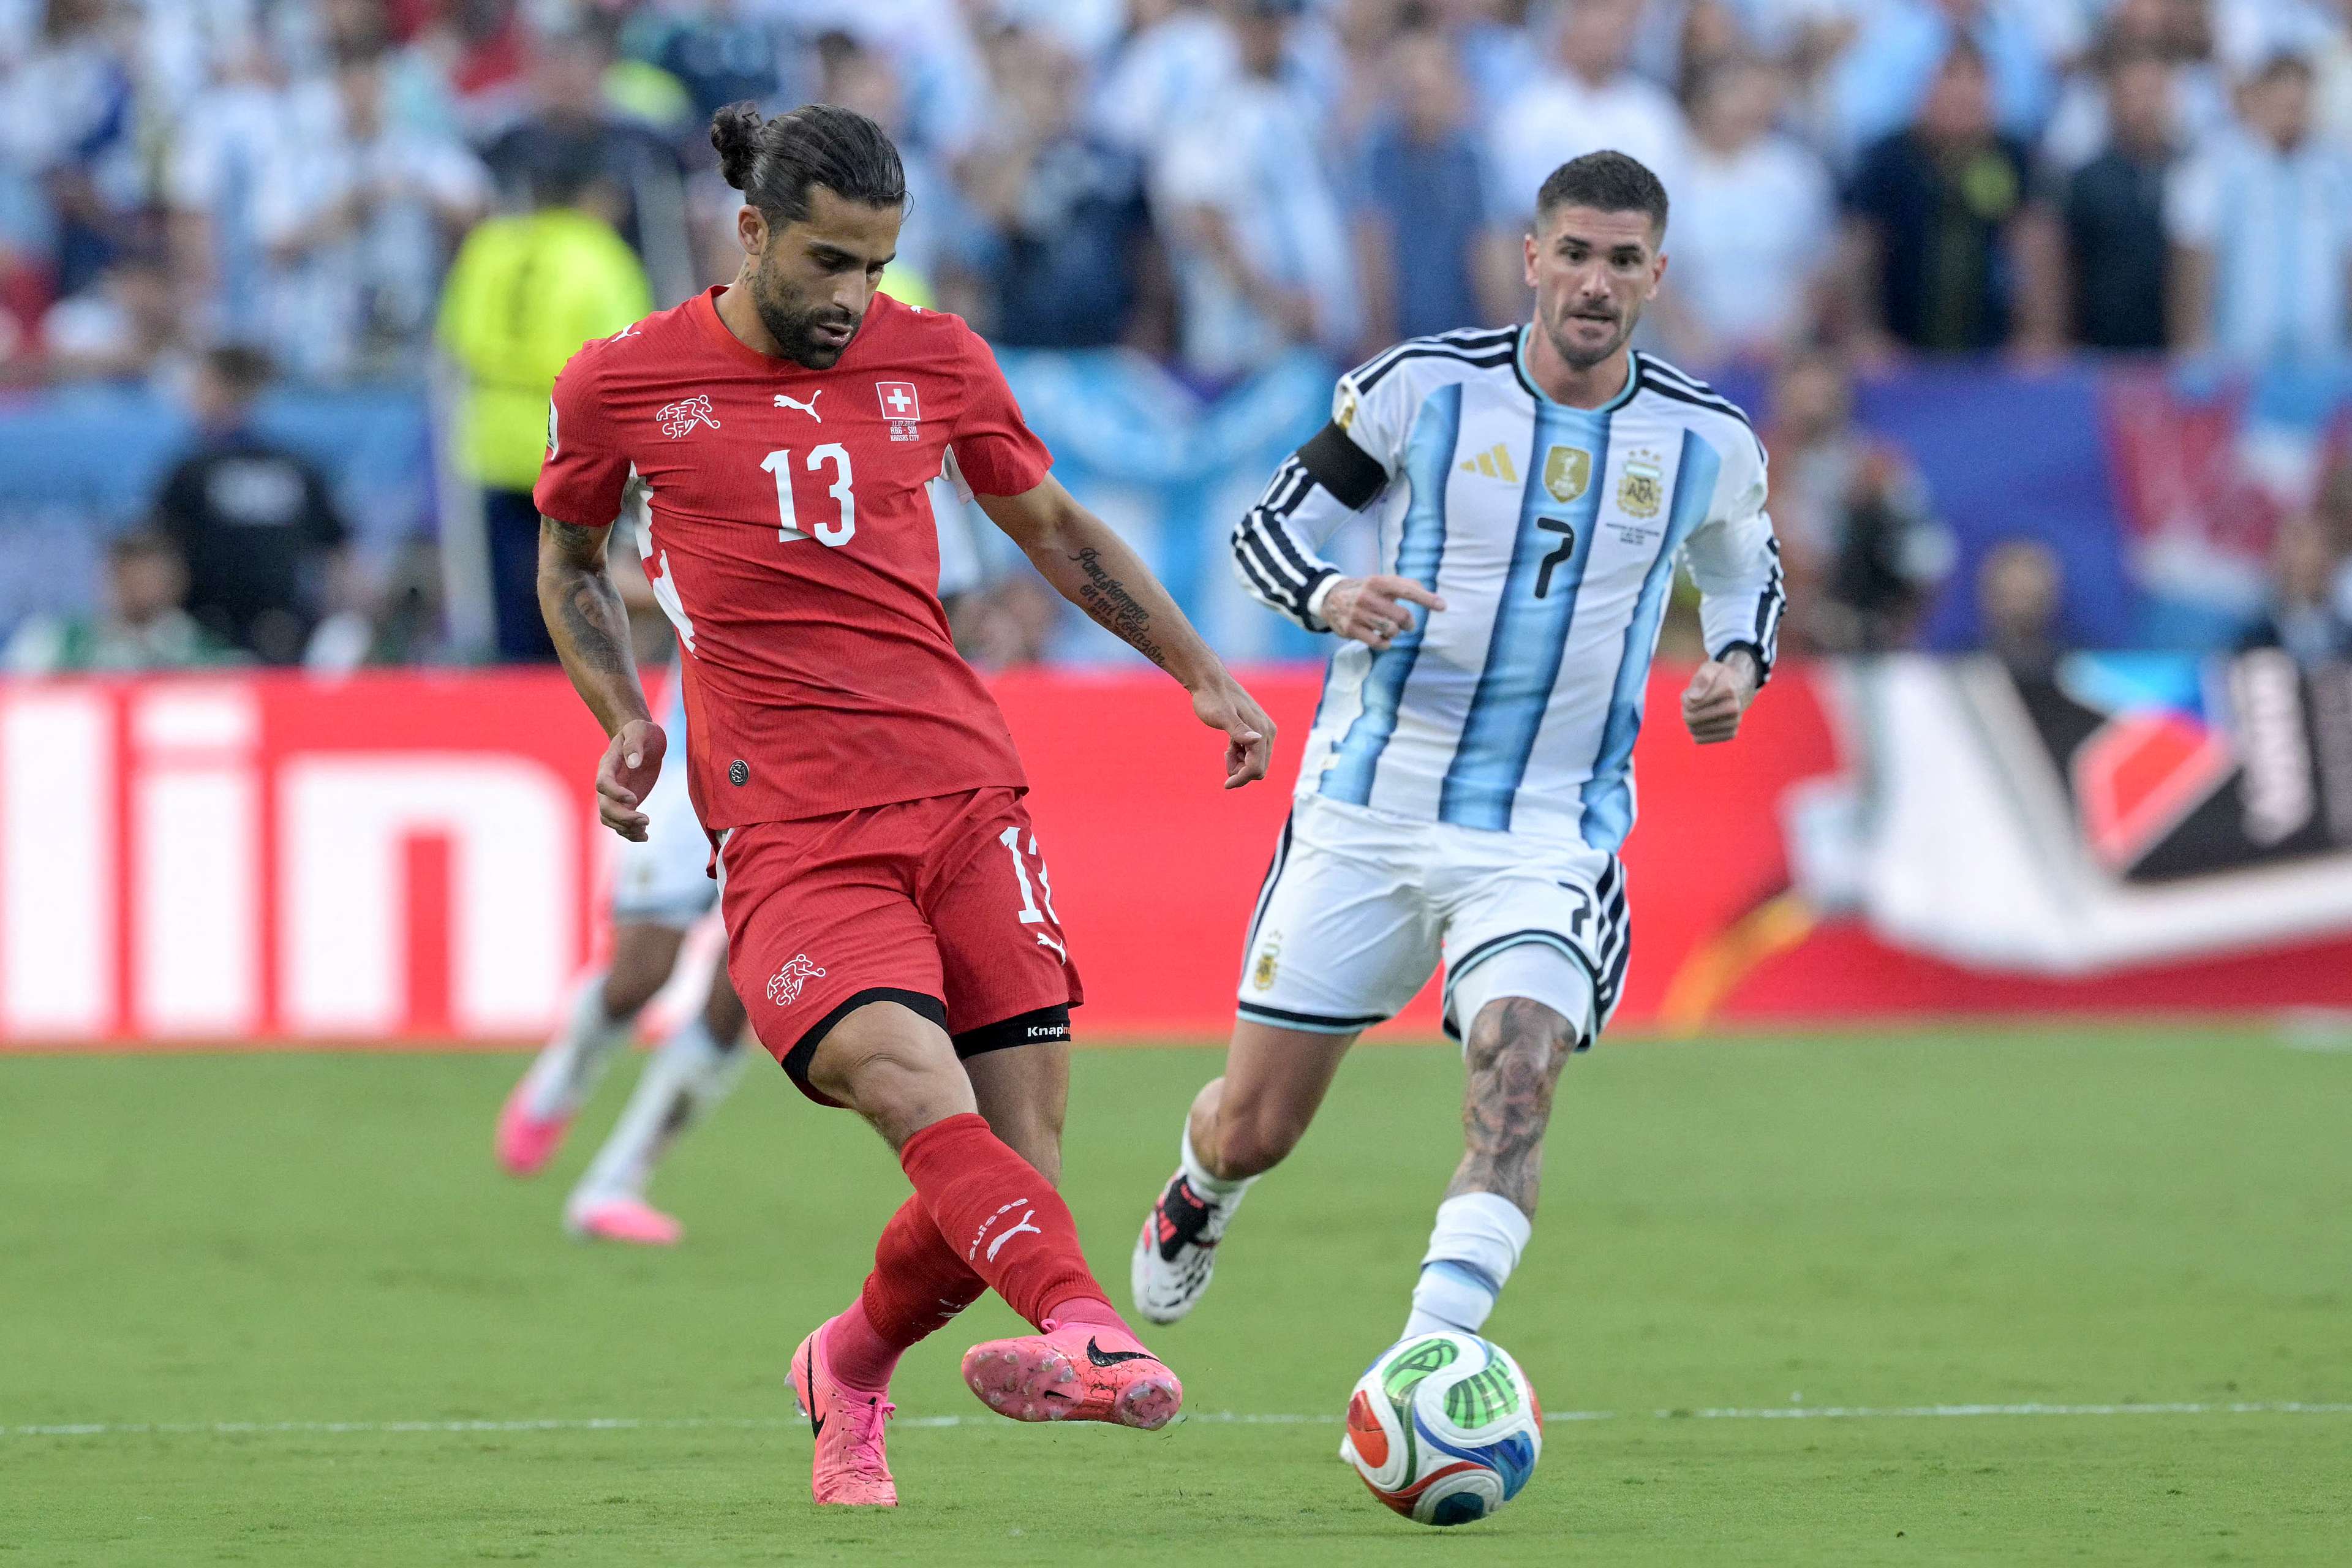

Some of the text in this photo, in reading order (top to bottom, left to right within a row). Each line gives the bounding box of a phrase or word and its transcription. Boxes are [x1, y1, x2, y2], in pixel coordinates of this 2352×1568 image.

[890, 426, 903, 435] ARG
[907, 426, 918, 434] SUI
[760, 442, 856, 548] 13
[1534, 517, 1575, 599] 7
[1558, 881, 1592, 938] 7
